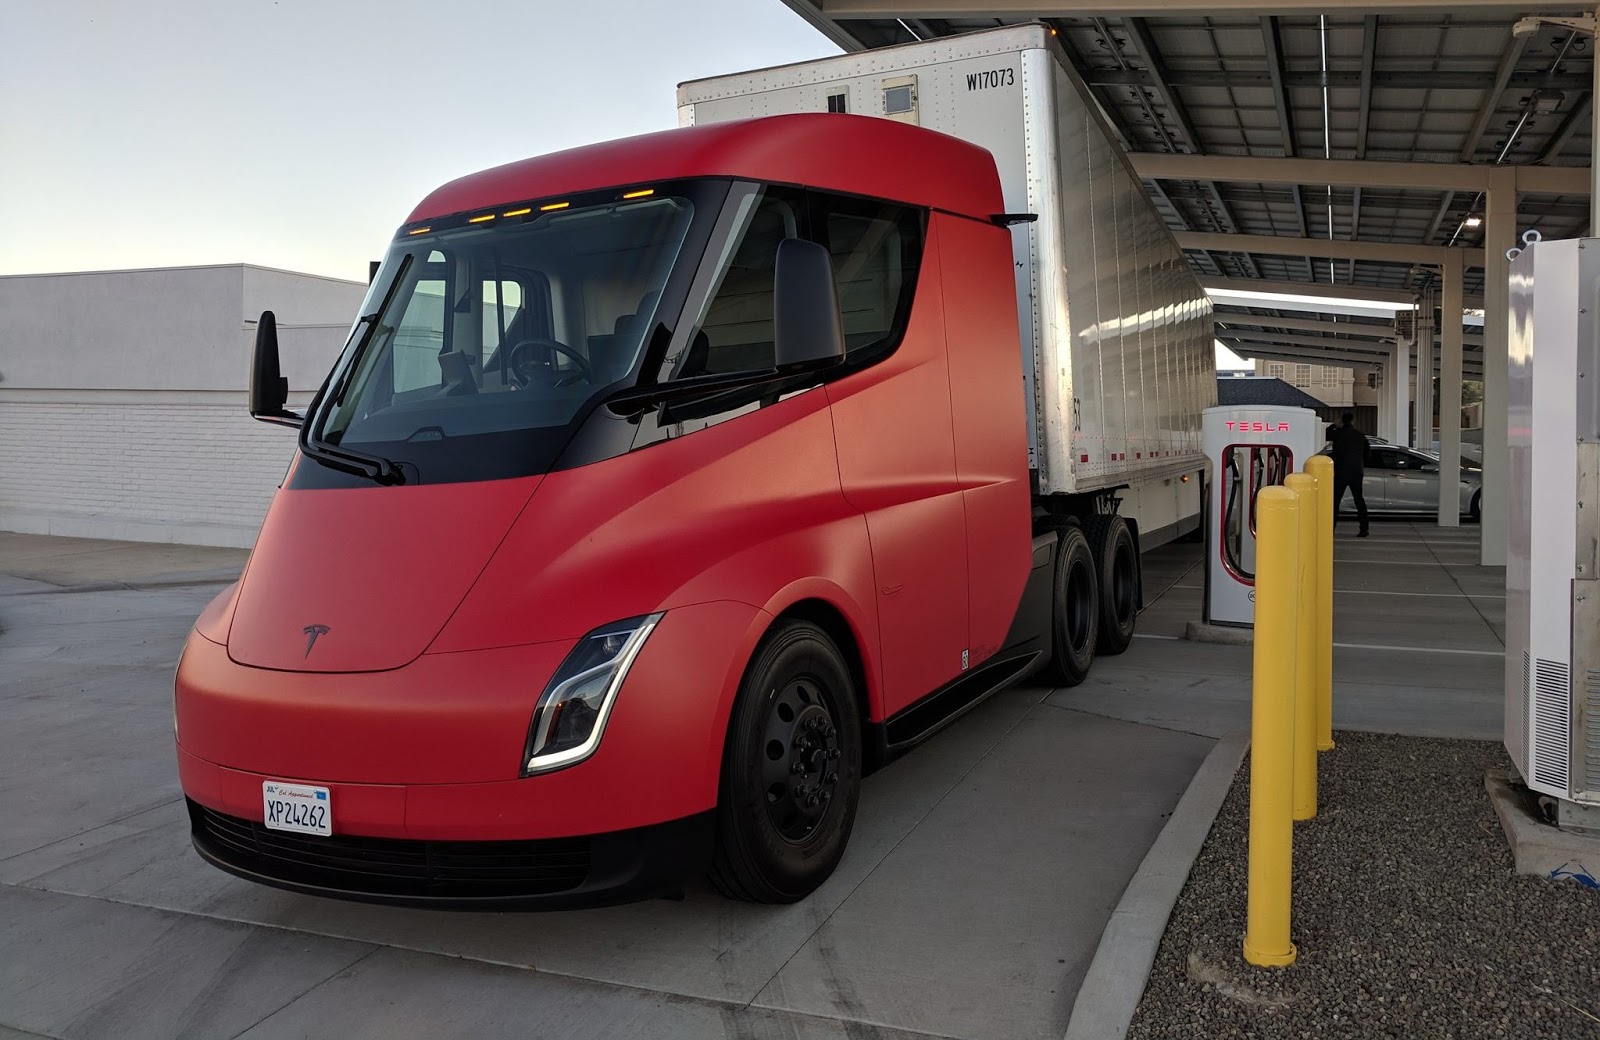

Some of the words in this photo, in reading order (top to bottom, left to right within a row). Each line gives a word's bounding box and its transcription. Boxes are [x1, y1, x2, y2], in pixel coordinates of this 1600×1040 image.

[966, 67, 1014, 91] W17073
[1225, 421, 1290, 432] TESLA
[267, 799, 326, 829] XP24262
